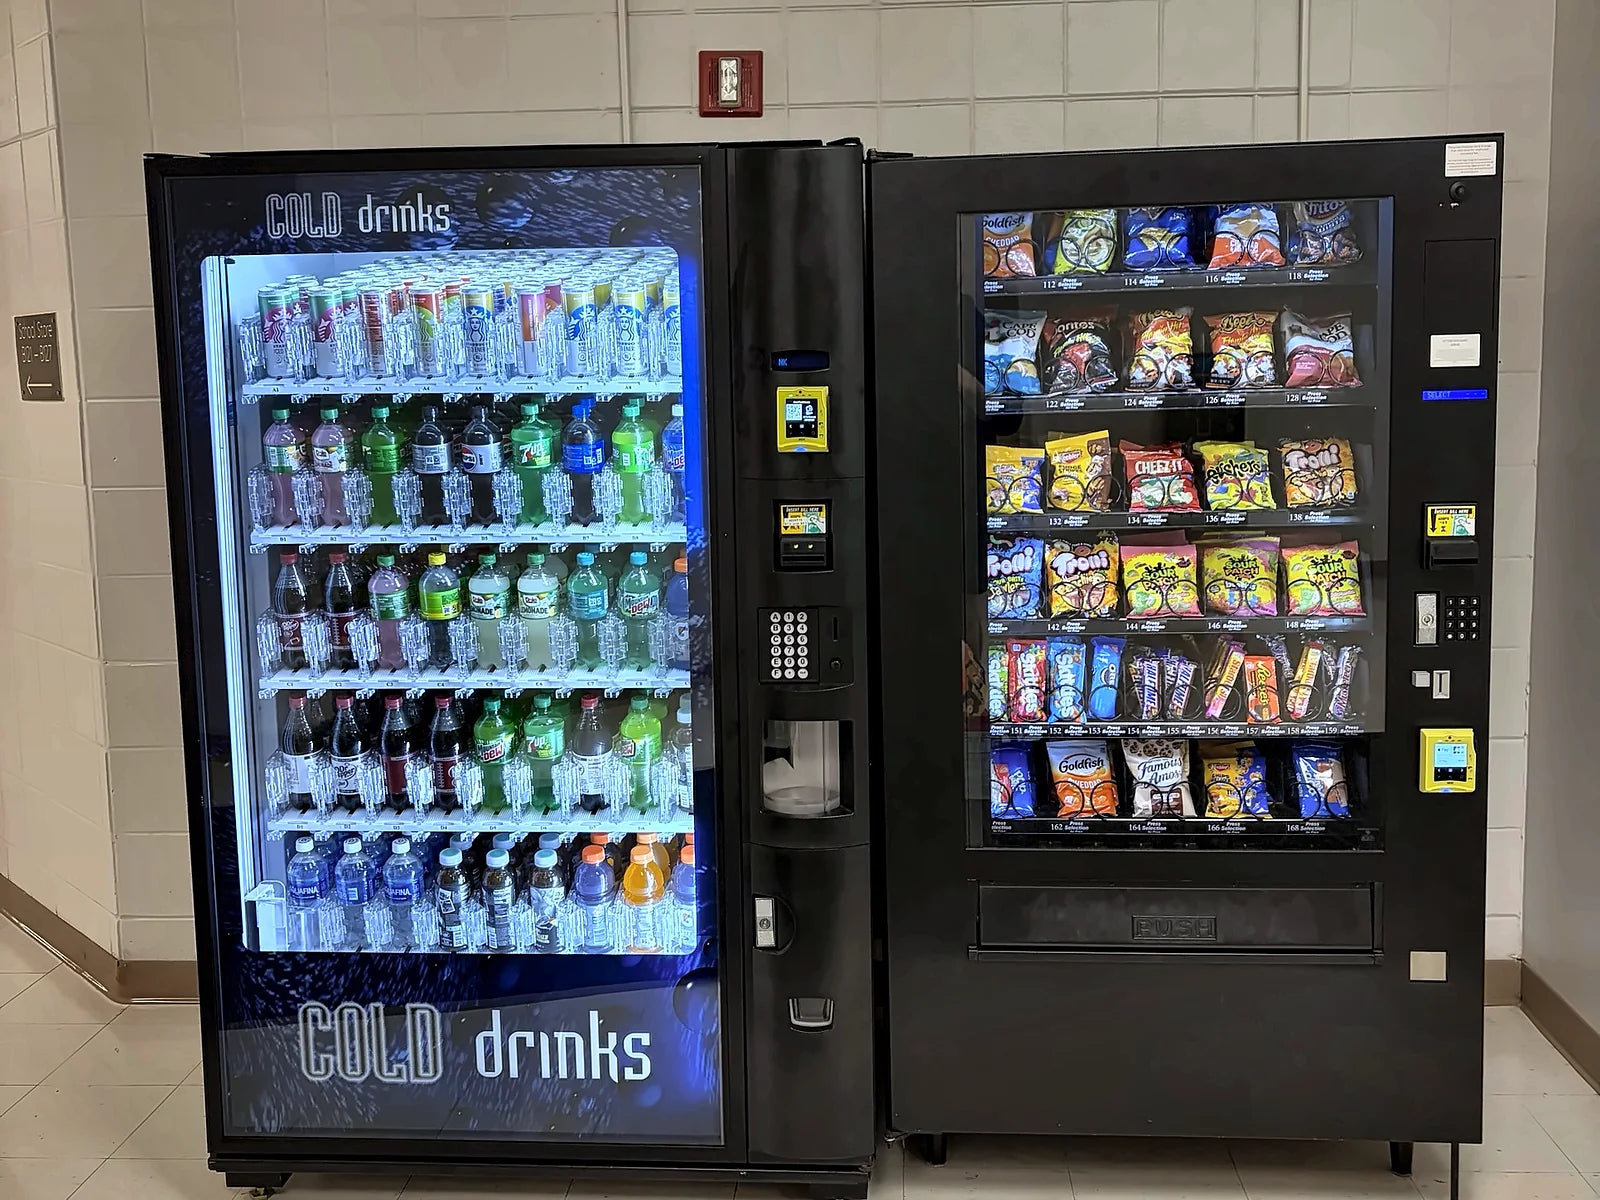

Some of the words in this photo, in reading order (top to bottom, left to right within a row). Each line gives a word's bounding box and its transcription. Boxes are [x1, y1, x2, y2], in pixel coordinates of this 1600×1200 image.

[265, 192, 342, 239] COLD
[358, 194, 451, 234] drinks
[1289, 273, 1302, 281] 118
[1002, 321, 1038, 330] CAPE
[1006, 328, 1036, 339] COD
[1205, 396, 1218, 404] 126
[1286, 394, 1299, 402] 128
[1046, 401, 1058, 409] 122
[1205, 515, 1218, 523] 136
[1050, 550, 1110, 579] Trolli
[1308, 562, 1344, 573] SOUR
[1059, 757, 1105, 773] Goldfish
[1137, 757, 1182, 781] Famous
[1149, 769, 1181, 785] Amos
[301, 1001, 443, 1083] COLD
[476, 1009, 652, 1083] drinks
